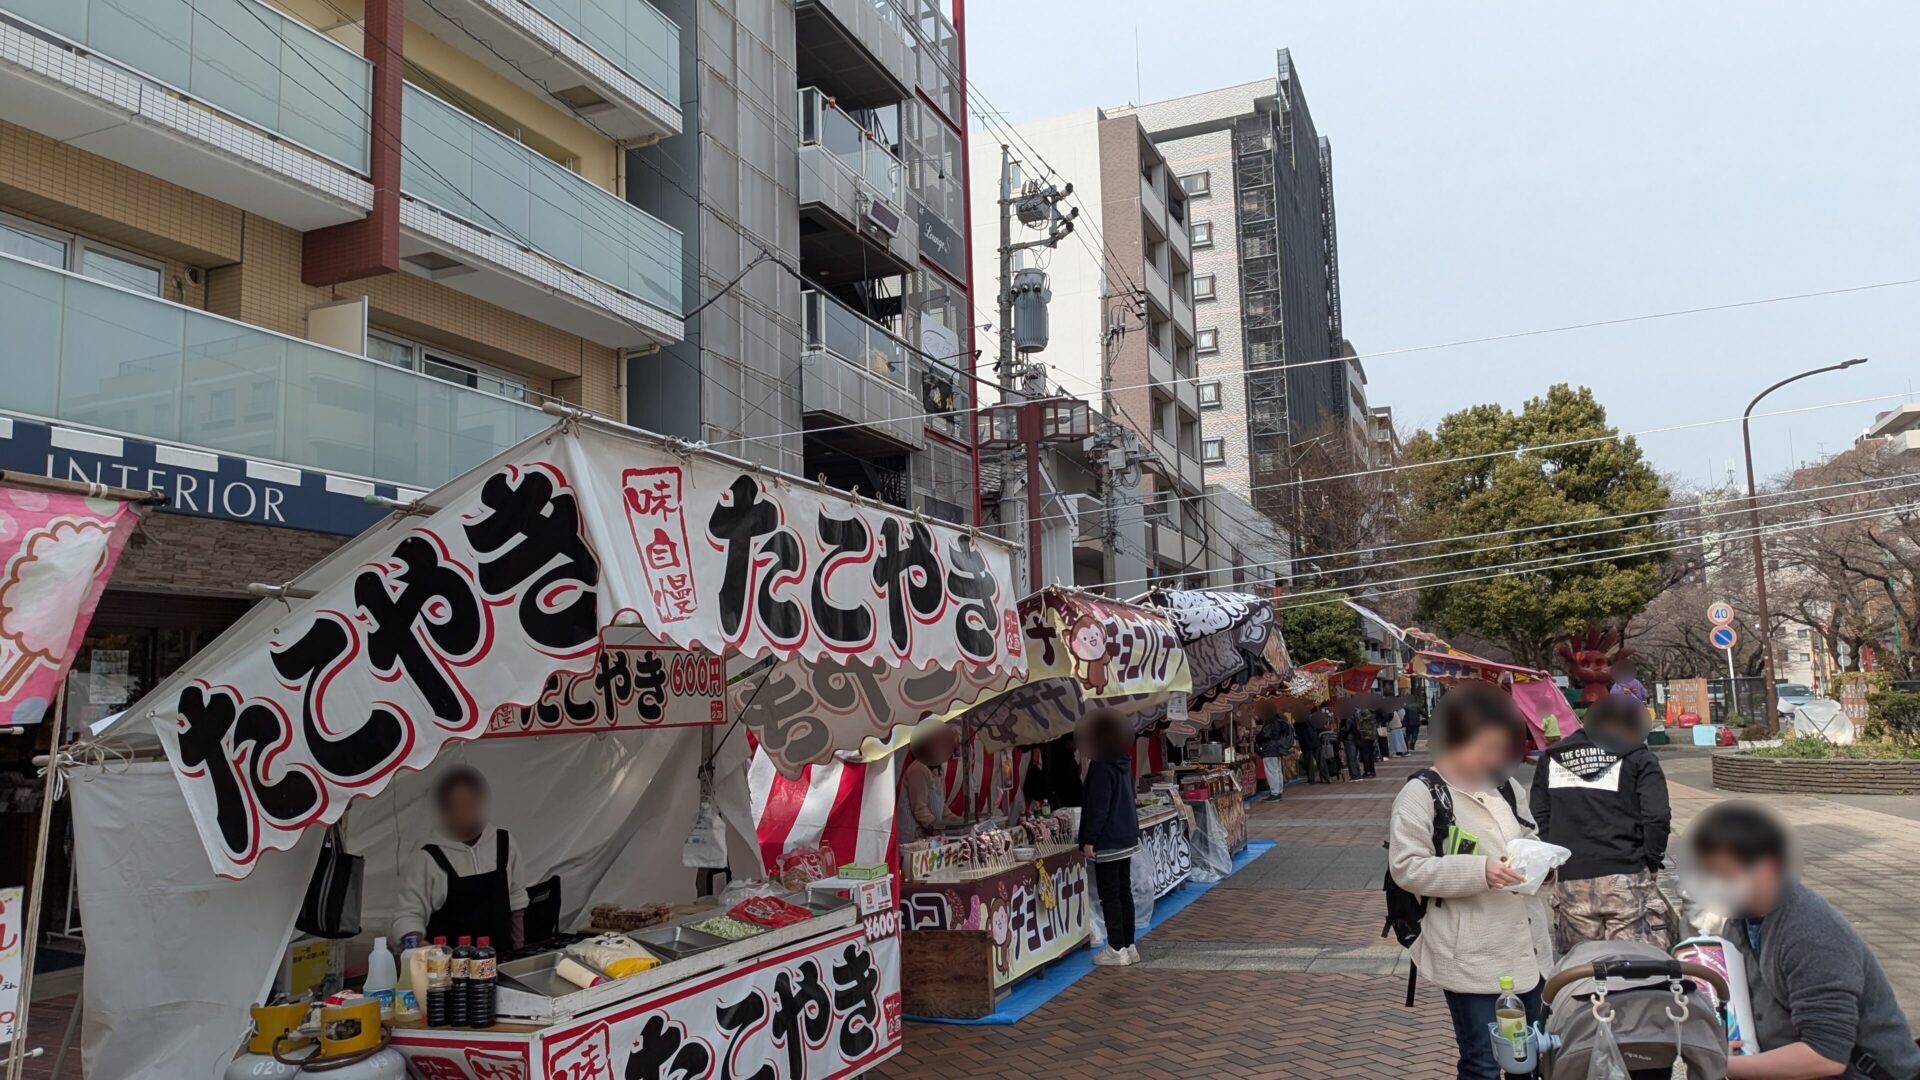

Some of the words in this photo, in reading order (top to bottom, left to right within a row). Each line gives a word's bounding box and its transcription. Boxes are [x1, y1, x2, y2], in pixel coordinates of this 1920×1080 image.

[623, 482, 698, 618] 味自慢
[707, 474, 998, 658] たこやき
[1714, 608, 1728, 620] 40
[176, 470, 598, 855] たこやき
[672, 653, 723, 697] 600円
[1560, 751, 1574, 760] THE
[864, 911, 895, 941] ¥600
